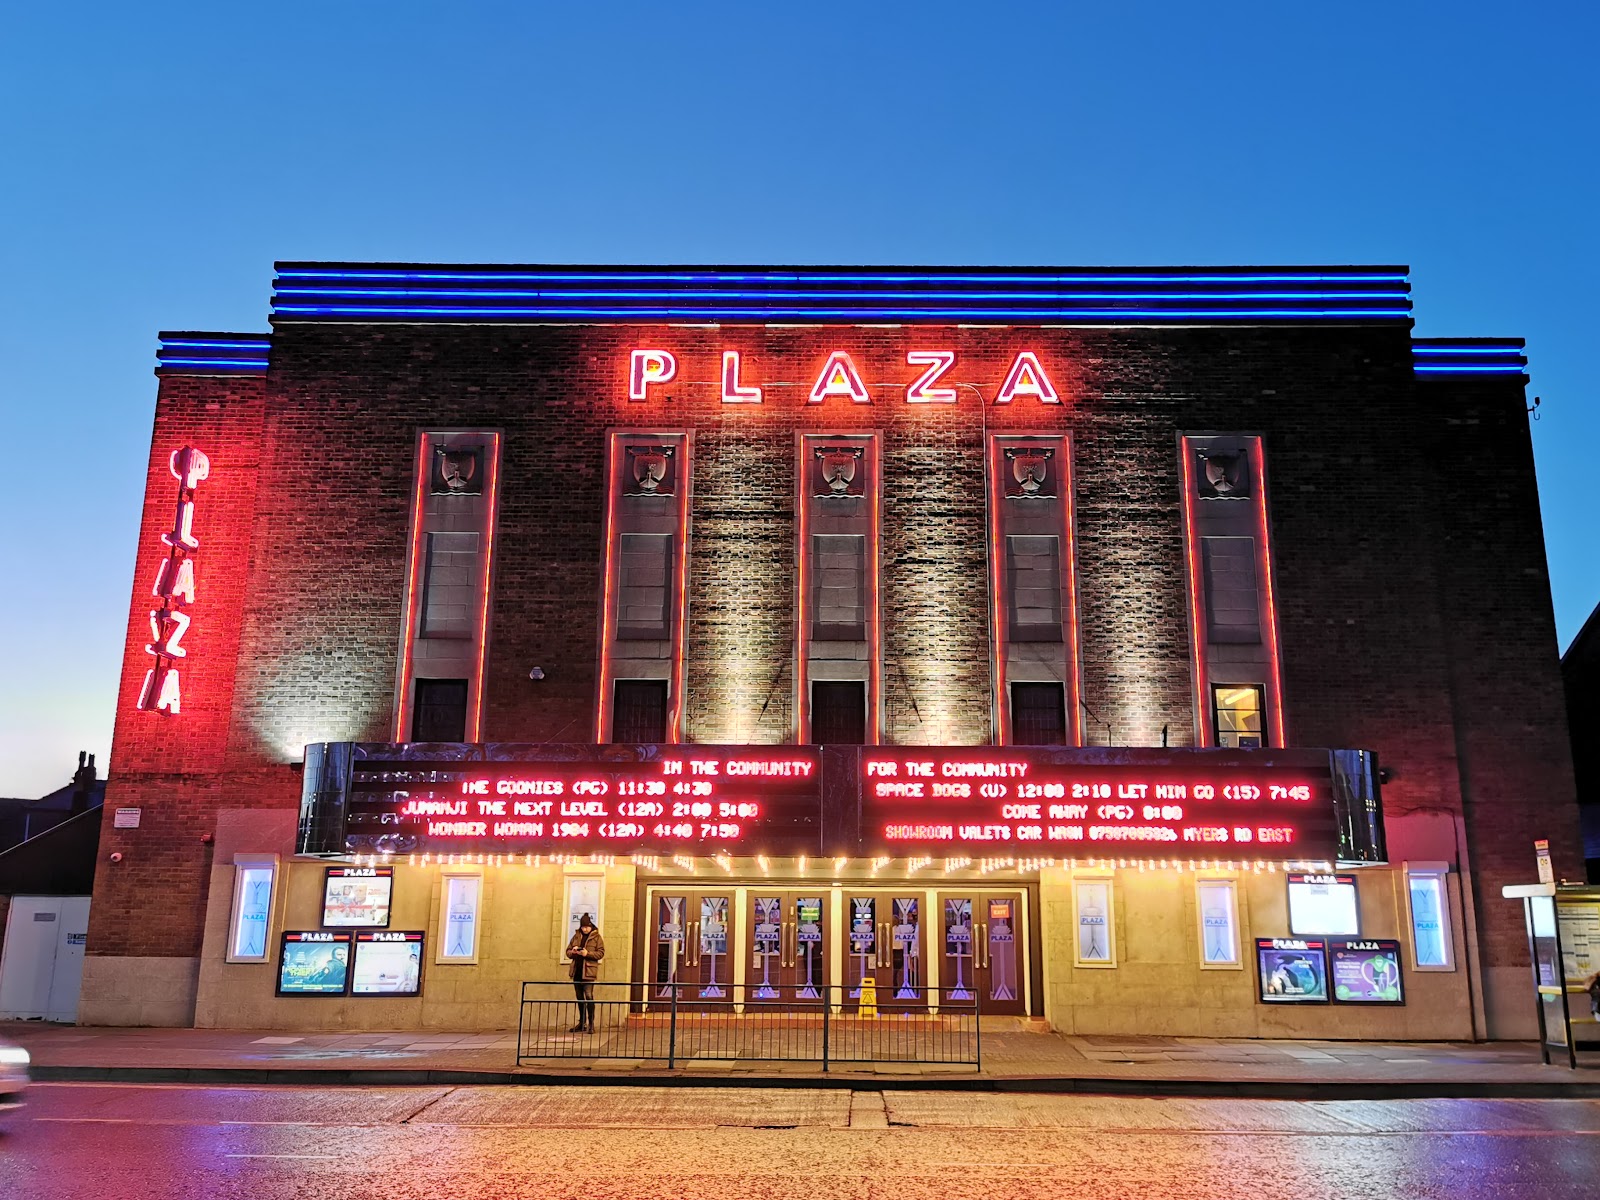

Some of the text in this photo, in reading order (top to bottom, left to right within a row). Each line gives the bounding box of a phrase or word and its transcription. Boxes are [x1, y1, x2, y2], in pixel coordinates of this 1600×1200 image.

[628, 349, 1059, 403] PLAZA
[146, 446, 210, 715] PLAZA
[663, 761, 812, 776] IN THE COMMUNITY
[867, 762, 1028, 777] FOR THE COMMUNITY
[497, 780, 564, 795] GOONIES
[572, 781, 609, 796] (PG)
[618, 781, 666, 796] 11:30
[672, 781, 713, 796] 4:30
[875, 783, 1311, 800] SPACE DOGS (U) 12:00 2:10 LET HIM GO (15) 7:45
[401, 801, 468, 816] JUMANJI
[477, 801, 507, 816] THE
[514, 801, 553, 816] NEXT
[560, 801, 608, 817] LEVEL
[618, 802, 664, 817] (12A)
[672, 802, 713, 817] 2:00
[1002, 804, 1042, 819] COME
[1048, 804, 1089, 819] AWAY
[1097, 805, 1134, 820] (PG)
[428, 822, 487, 836] WONDER
[493, 822, 543, 837] WOMAN
[551, 822, 590, 837] 1984
[598, 823, 645, 838] (12A)
[885, 825, 953, 840] SHOWROOM
[959, 825, 1012, 840] VALETS
[1016, 825, 1043, 840] CAR
[1048, 825, 1084, 841] WASH
[1183, 827, 1229, 842] MYERS
[1234, 827, 1253, 842] RD
[1258, 827, 1294, 842] EAST
[343, 868, 377, 877] PLAZA
[1303, 875, 1338, 884] PLAZA
[301, 933, 335, 941] PLAZA
[373, 932, 407, 941] PLAZA
[1272, 939, 1308, 950] PLAZA
[1346, 941, 1380, 950] PLAZA
